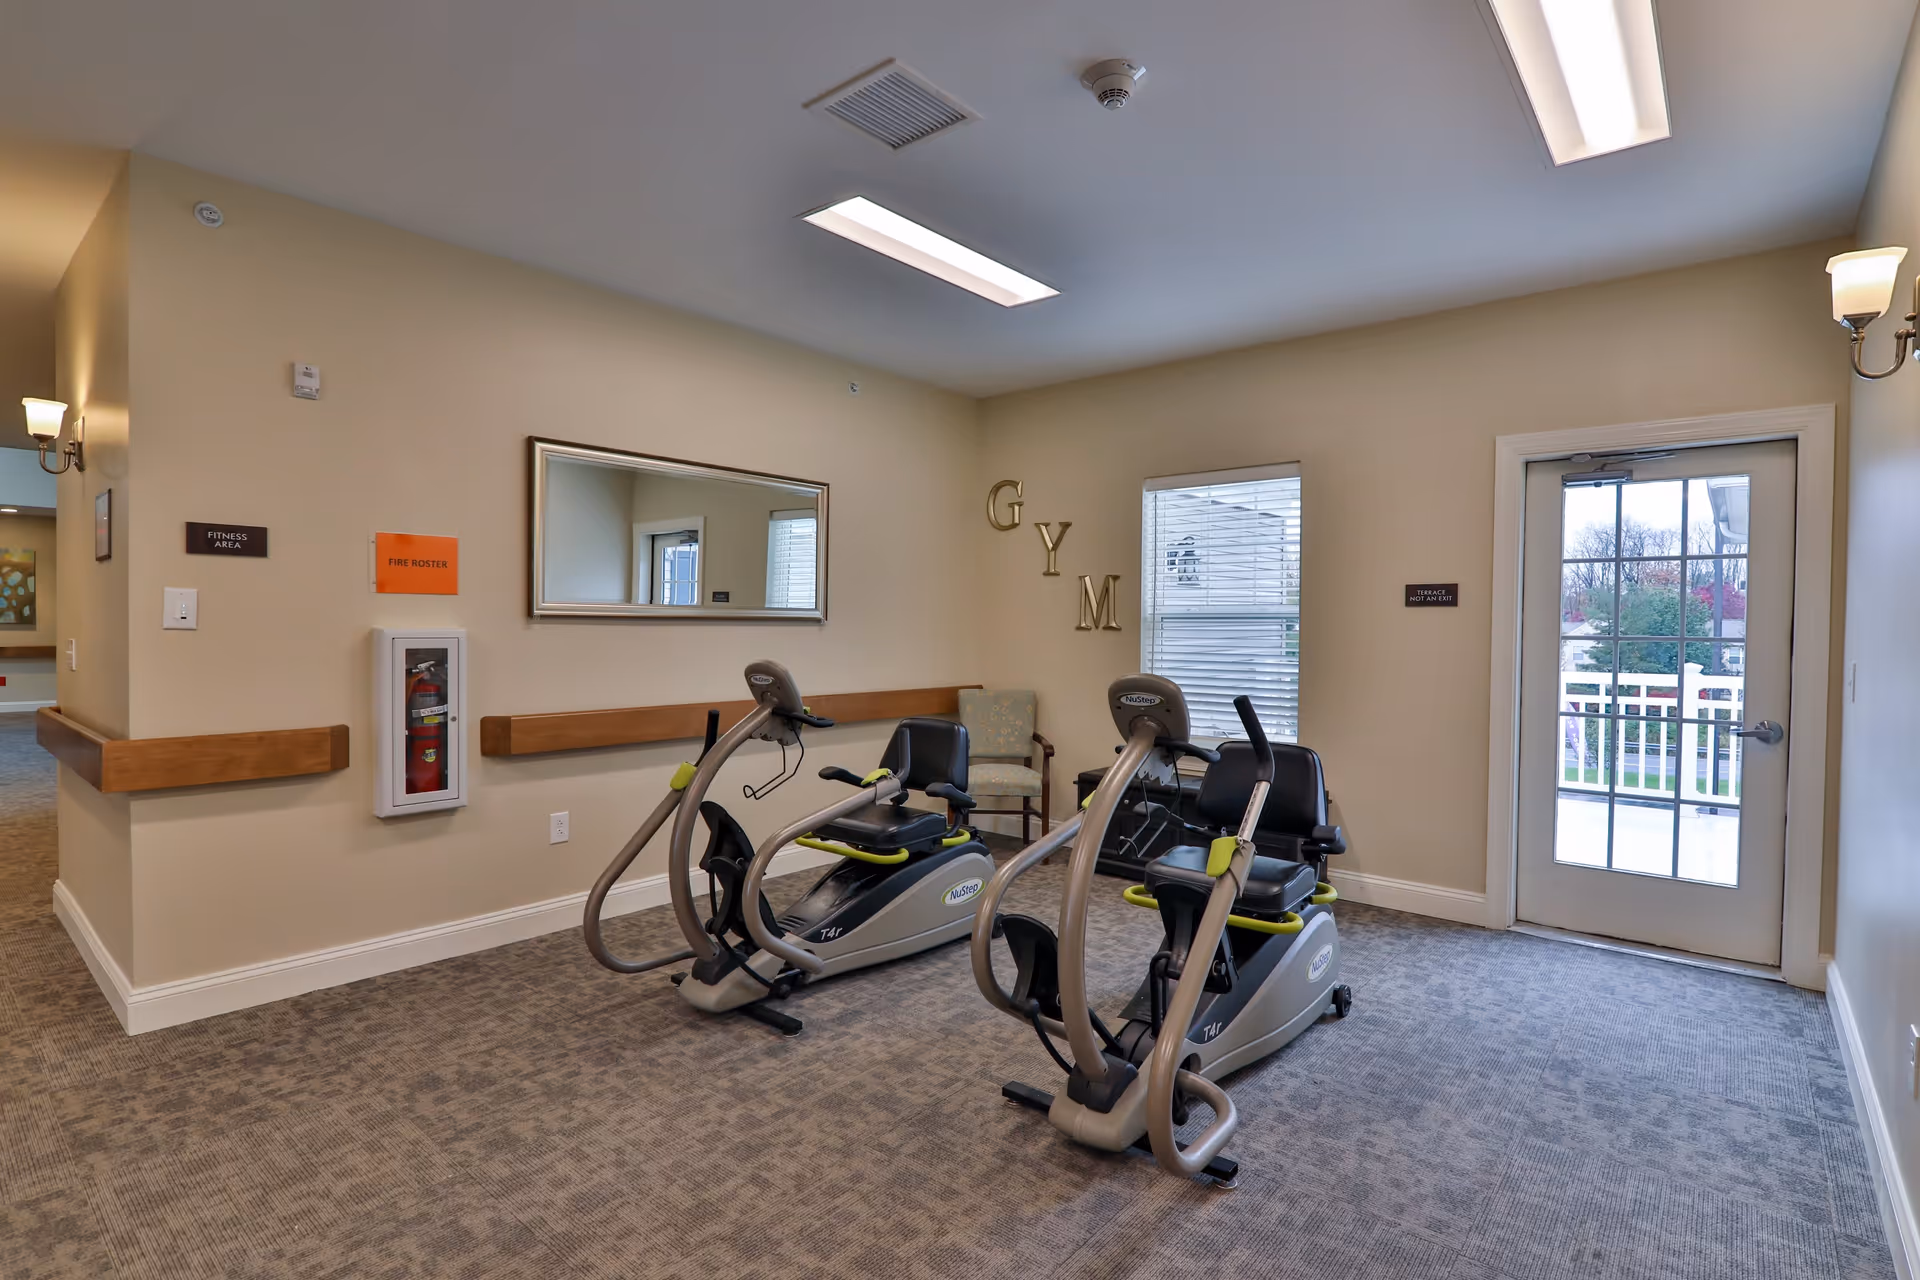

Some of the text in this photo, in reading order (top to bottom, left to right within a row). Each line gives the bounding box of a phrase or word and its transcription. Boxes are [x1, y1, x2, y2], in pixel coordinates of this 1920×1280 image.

[207, 531, 248, 541] FITNESS
[214, 540, 242, 549] AREA
[986, 479, 1122, 631] GYM
[388, 557, 448, 569] FIRE ROSTER
[1125, 696, 1156, 705] NuStep
[949, 883, 979, 901] NuStep
[820, 927, 843, 941] T4r
[1311, 950, 1331, 974] NuStep
